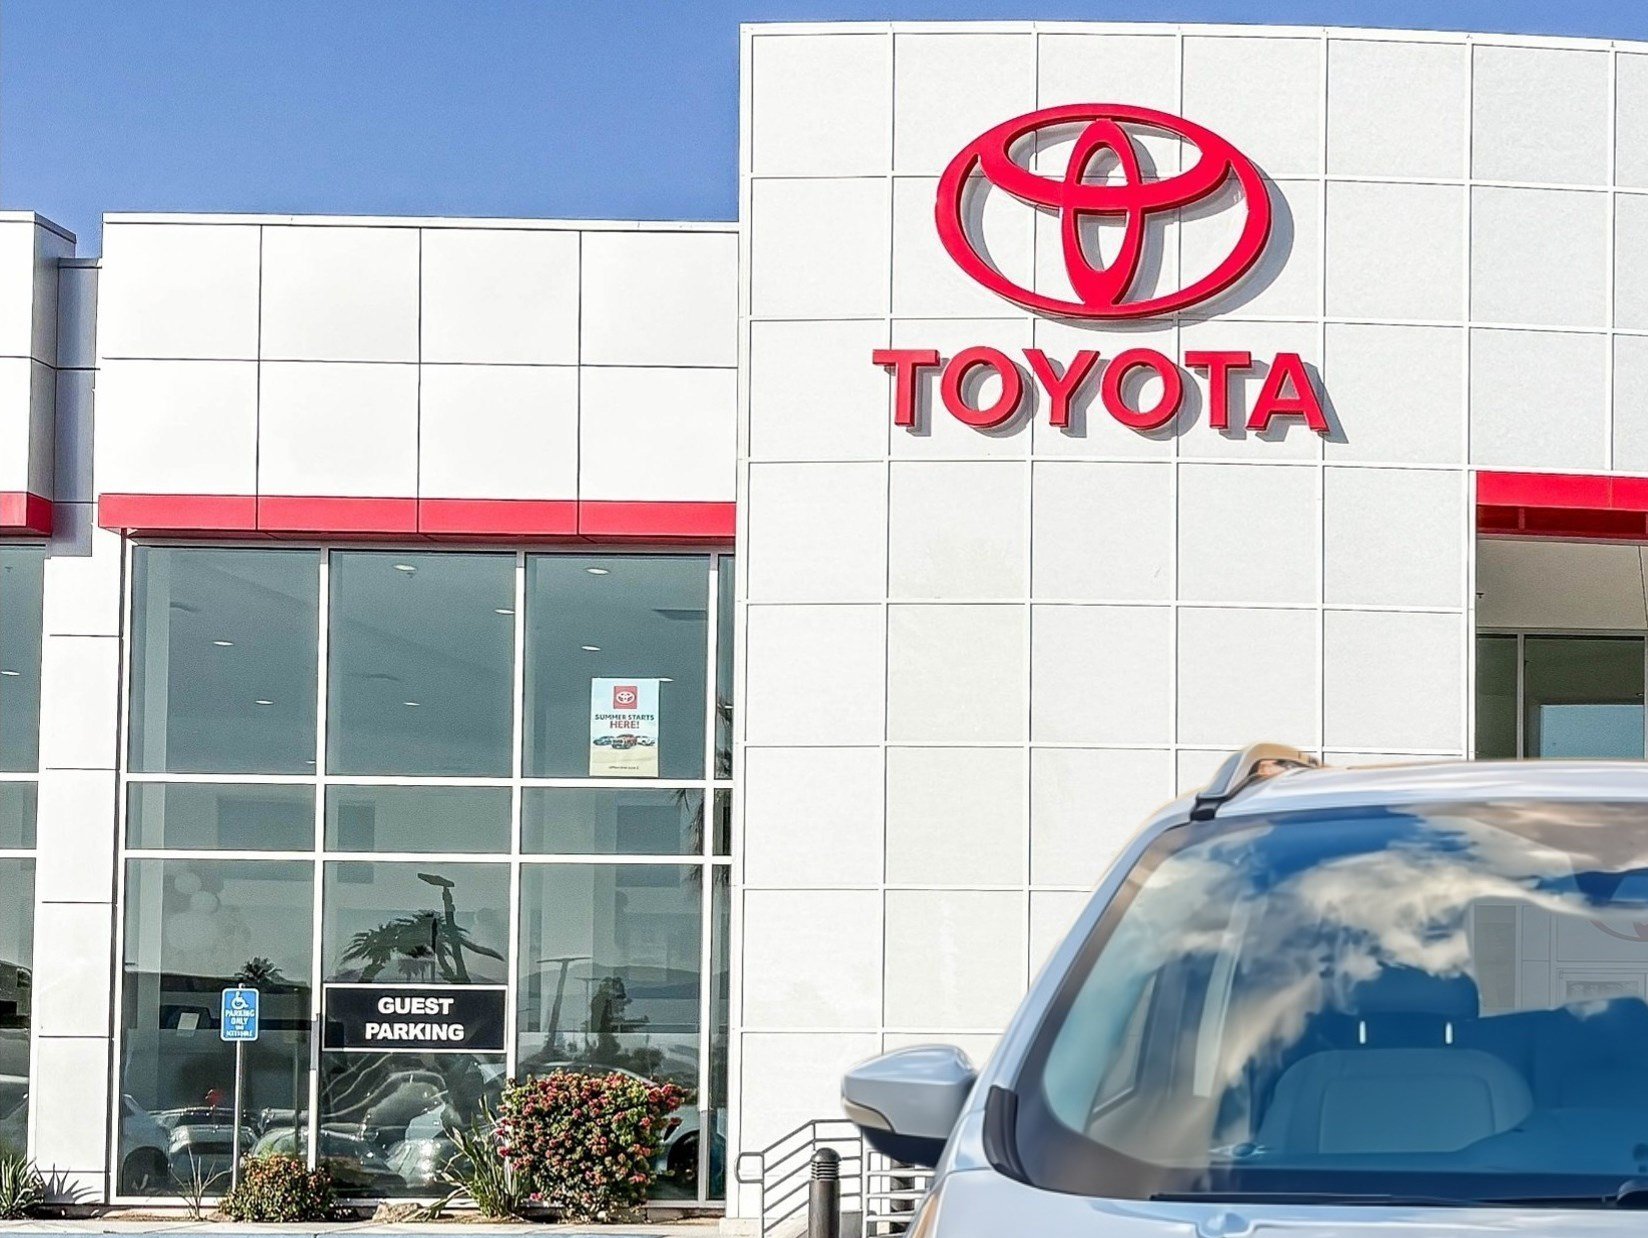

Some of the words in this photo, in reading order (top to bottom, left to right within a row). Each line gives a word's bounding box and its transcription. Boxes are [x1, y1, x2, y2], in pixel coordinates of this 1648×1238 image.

[872, 346, 1330, 435] TOYOTA
[609, 720, 640, 729] HERE!
[377, 996, 454, 1015] GUEST
[225, 1009, 255, 1018] PARKING
[230, 1017, 249, 1025] ONLY
[365, 1022, 465, 1041] PARKING
